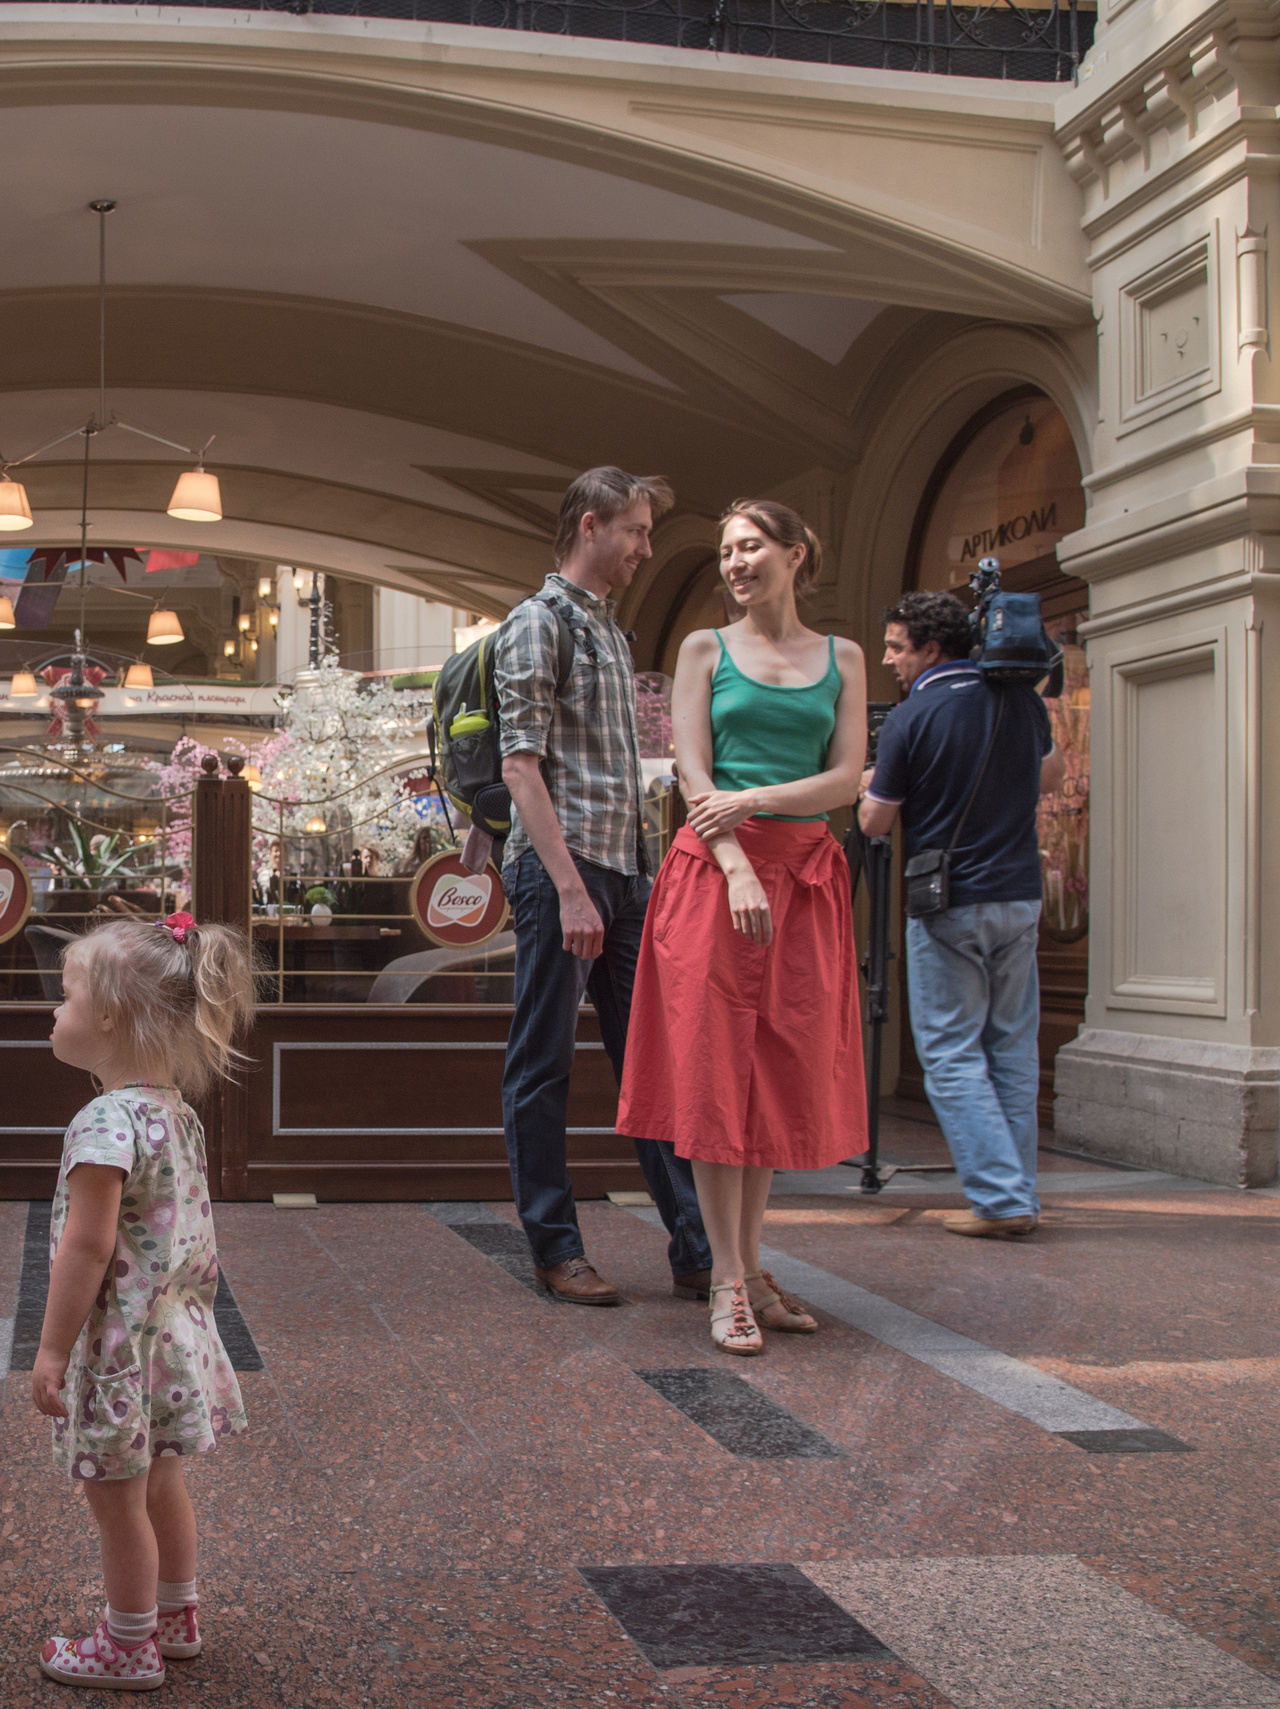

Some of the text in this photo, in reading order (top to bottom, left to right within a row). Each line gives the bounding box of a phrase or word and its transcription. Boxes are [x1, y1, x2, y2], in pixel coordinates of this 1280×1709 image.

[960, 502, 1057, 563] АРТИКОЛИ
[146, 690, 195, 704] Красной
[198, 694, 246, 707] площади
[437, 887, 483, 907] Bosco
